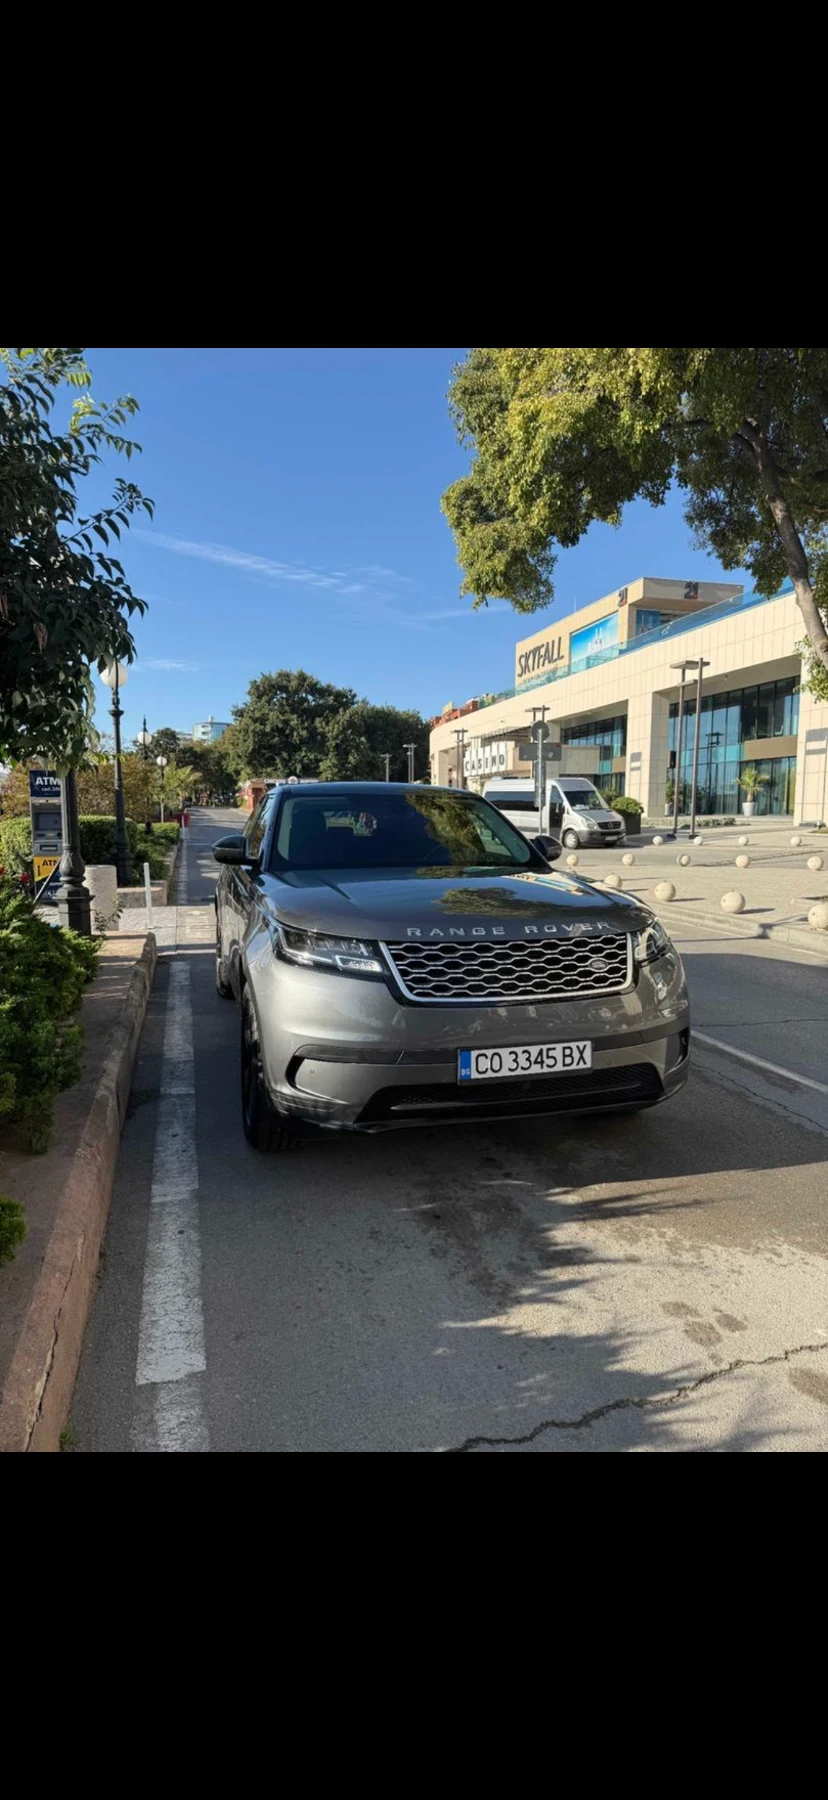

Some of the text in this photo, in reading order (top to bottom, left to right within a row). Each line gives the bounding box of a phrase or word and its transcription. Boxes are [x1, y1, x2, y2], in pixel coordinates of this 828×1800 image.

[683, 581, 699, 599] 21
[517, 636, 564, 678] SKYFALL
[465, 754, 505, 771] CASINO
[35, 776, 61, 786] ATM
[406, 920, 609, 937] RANGE ROVER
[475, 1044, 588, 1075] CO 3345 BX
[461, 1068, 471, 1076] BG
